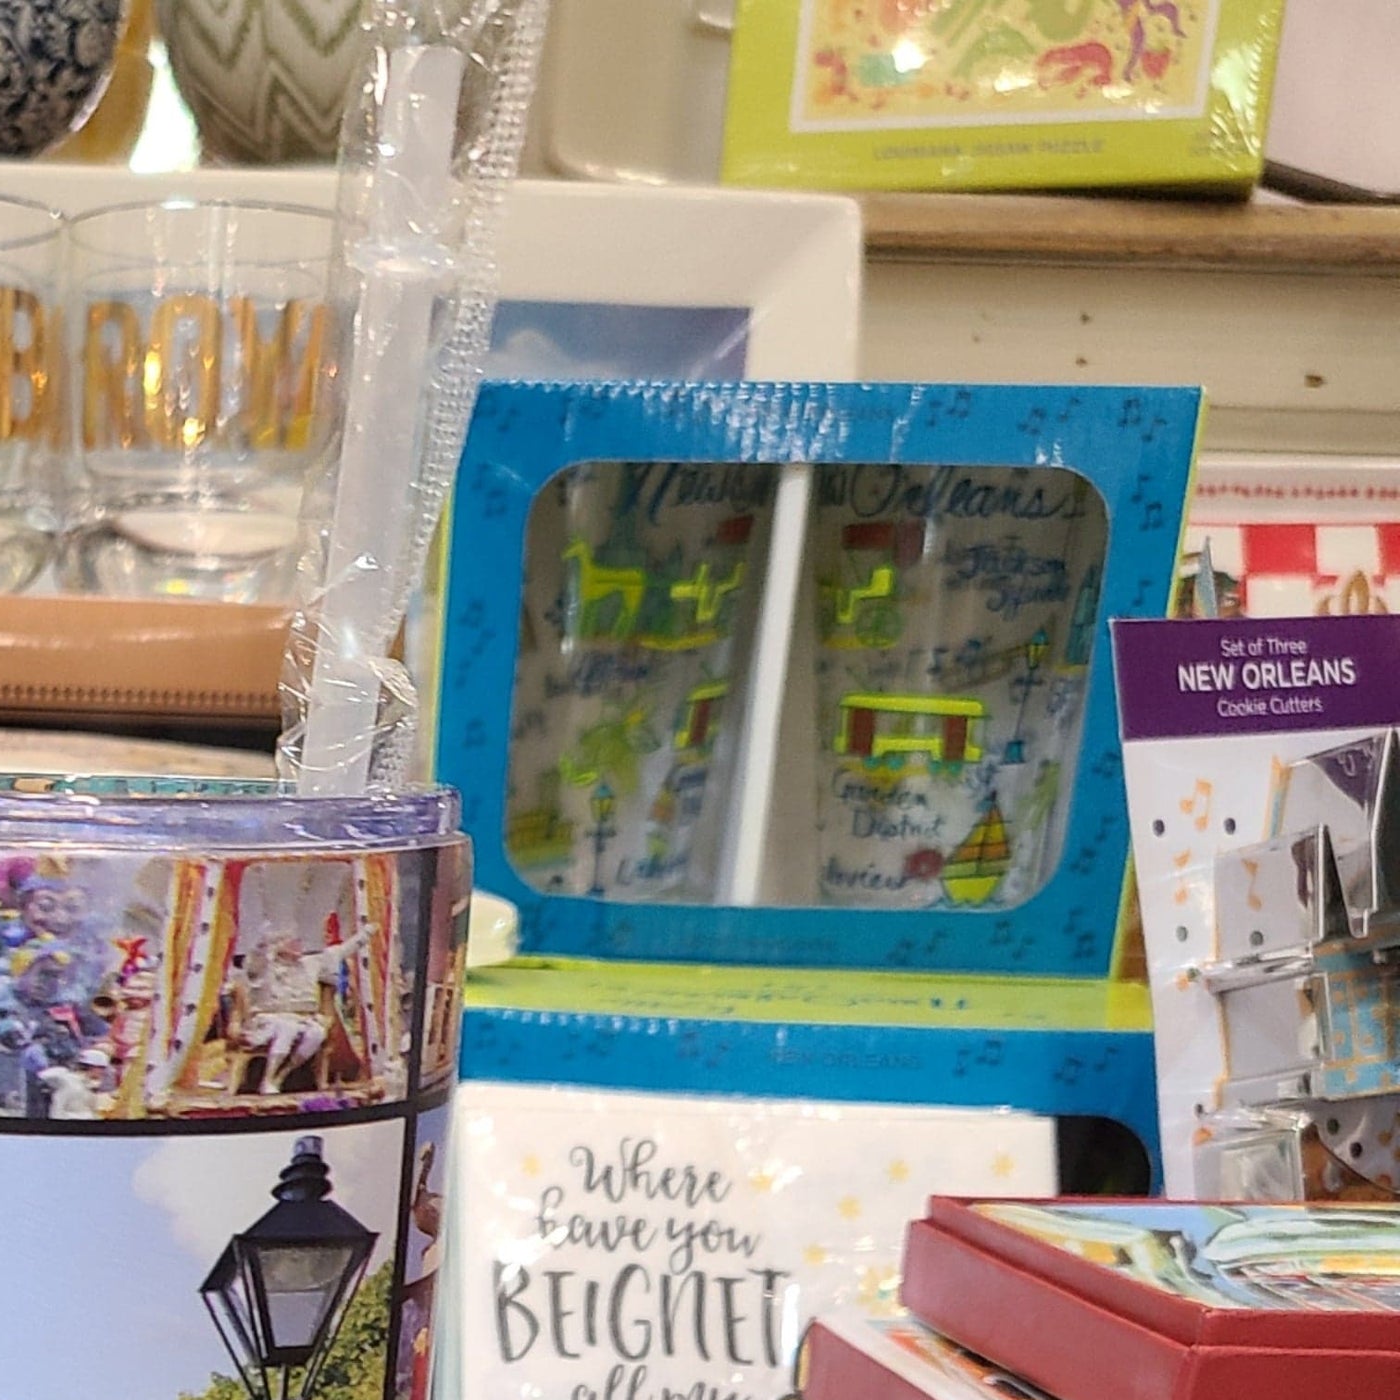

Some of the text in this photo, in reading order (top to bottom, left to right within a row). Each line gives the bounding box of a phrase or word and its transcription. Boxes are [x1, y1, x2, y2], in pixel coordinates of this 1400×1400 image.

[1220, 636, 1308, 658] Set of Three
[1177, 657, 1357, 693] NEW ORLEANS
[1216, 696, 1324, 718] Cookie Cutters
[568, 1135, 733, 1207] Where
[532, 1187, 763, 1276] have you
[490, 1260, 793, 1368] BEIGNET
